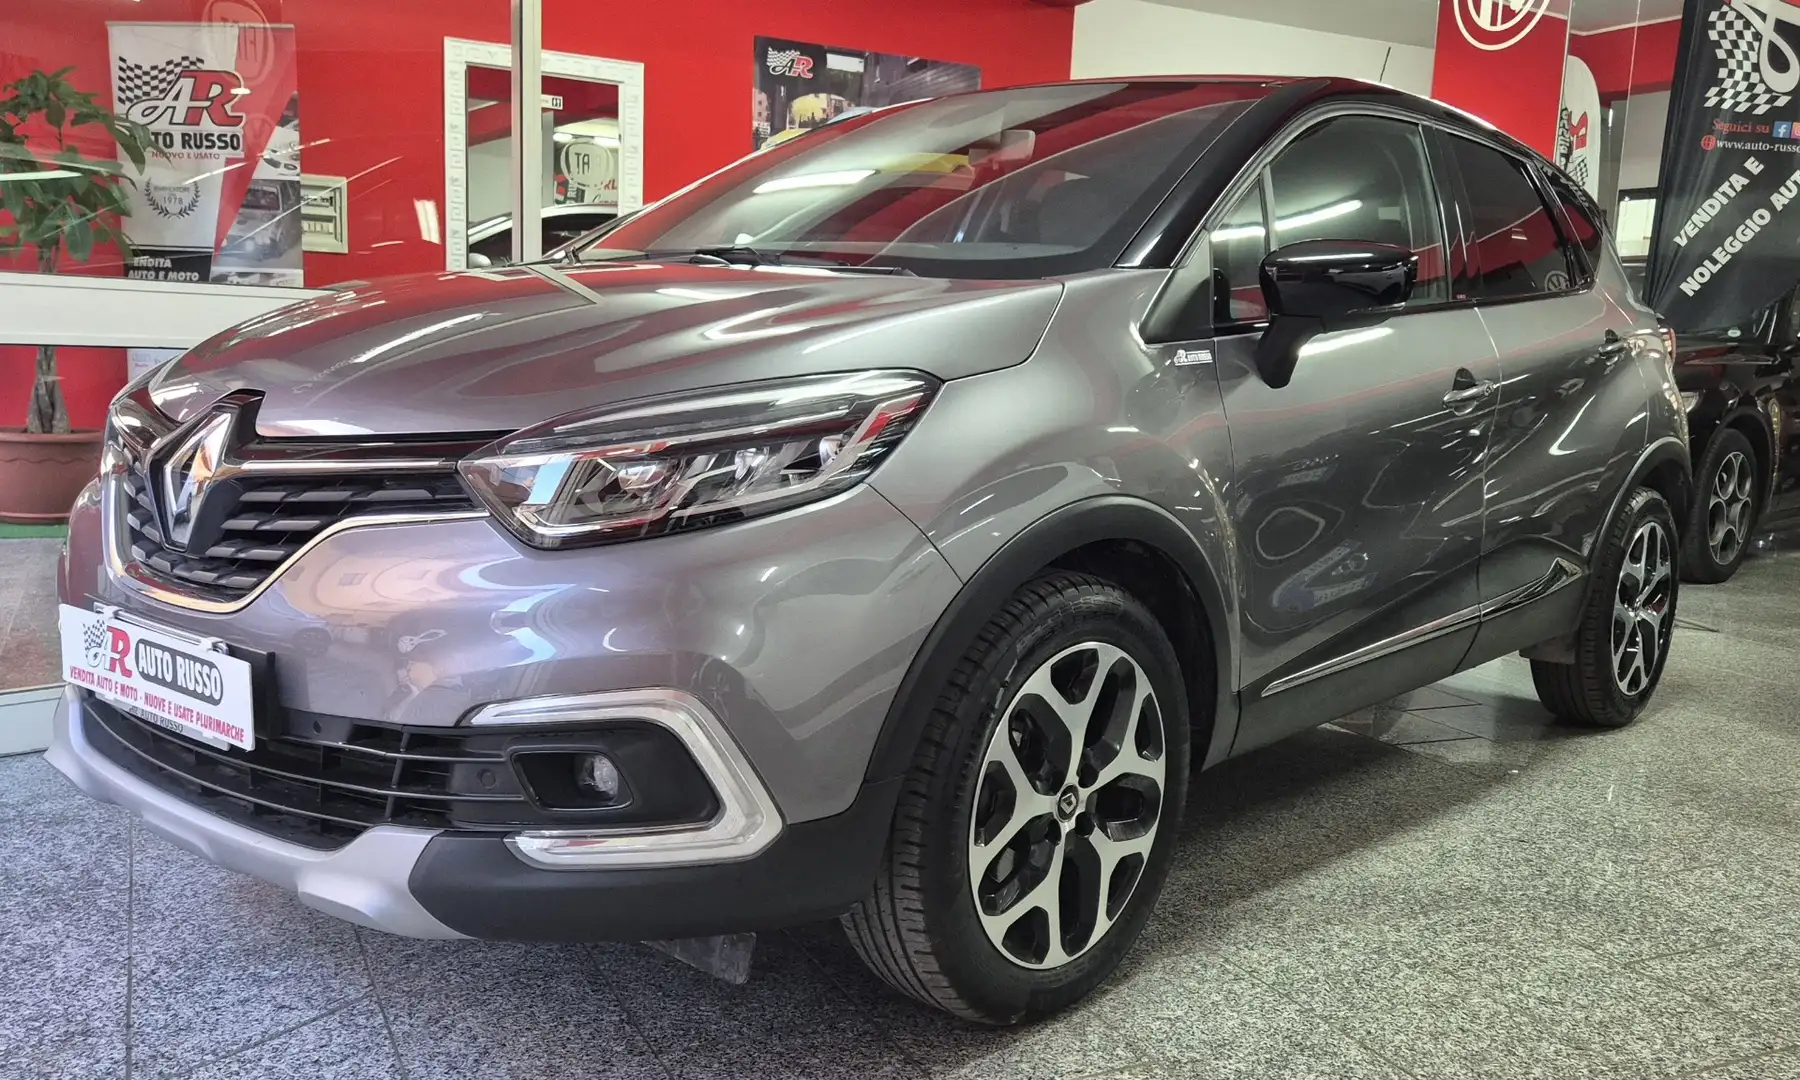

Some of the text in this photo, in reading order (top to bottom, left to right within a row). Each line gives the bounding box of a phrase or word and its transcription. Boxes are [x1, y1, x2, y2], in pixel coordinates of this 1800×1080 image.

[1713, 118, 1770, 135] Seguici su
[150, 131, 241, 151] TO RUSSO
[194, 152, 220, 160] USATO
[1673, 156, 1765, 247] VENDITA E
[133, 257, 172, 268] ENDITA
[1679, 208, 1771, 297] NOLEGGIO
[127, 270, 200, 281] AUTO E MOTO
[138, 642, 221, 700] AUTO RUSSO
[70, 666, 95, 685] VENDITA
[96, 675, 113, 693] AUTO
[115, 681, 119, 695] E
[120, 684, 138, 702] MOTO
[144, 691, 167, 713] NUOVE
[168, 701, 172, 716] E
[174, 703, 194, 723] USATE
[196, 711, 245, 744] PLURIMARCHE
[140, 709, 159, 724] AUTO
[159, 715, 184, 734] RUSSO
